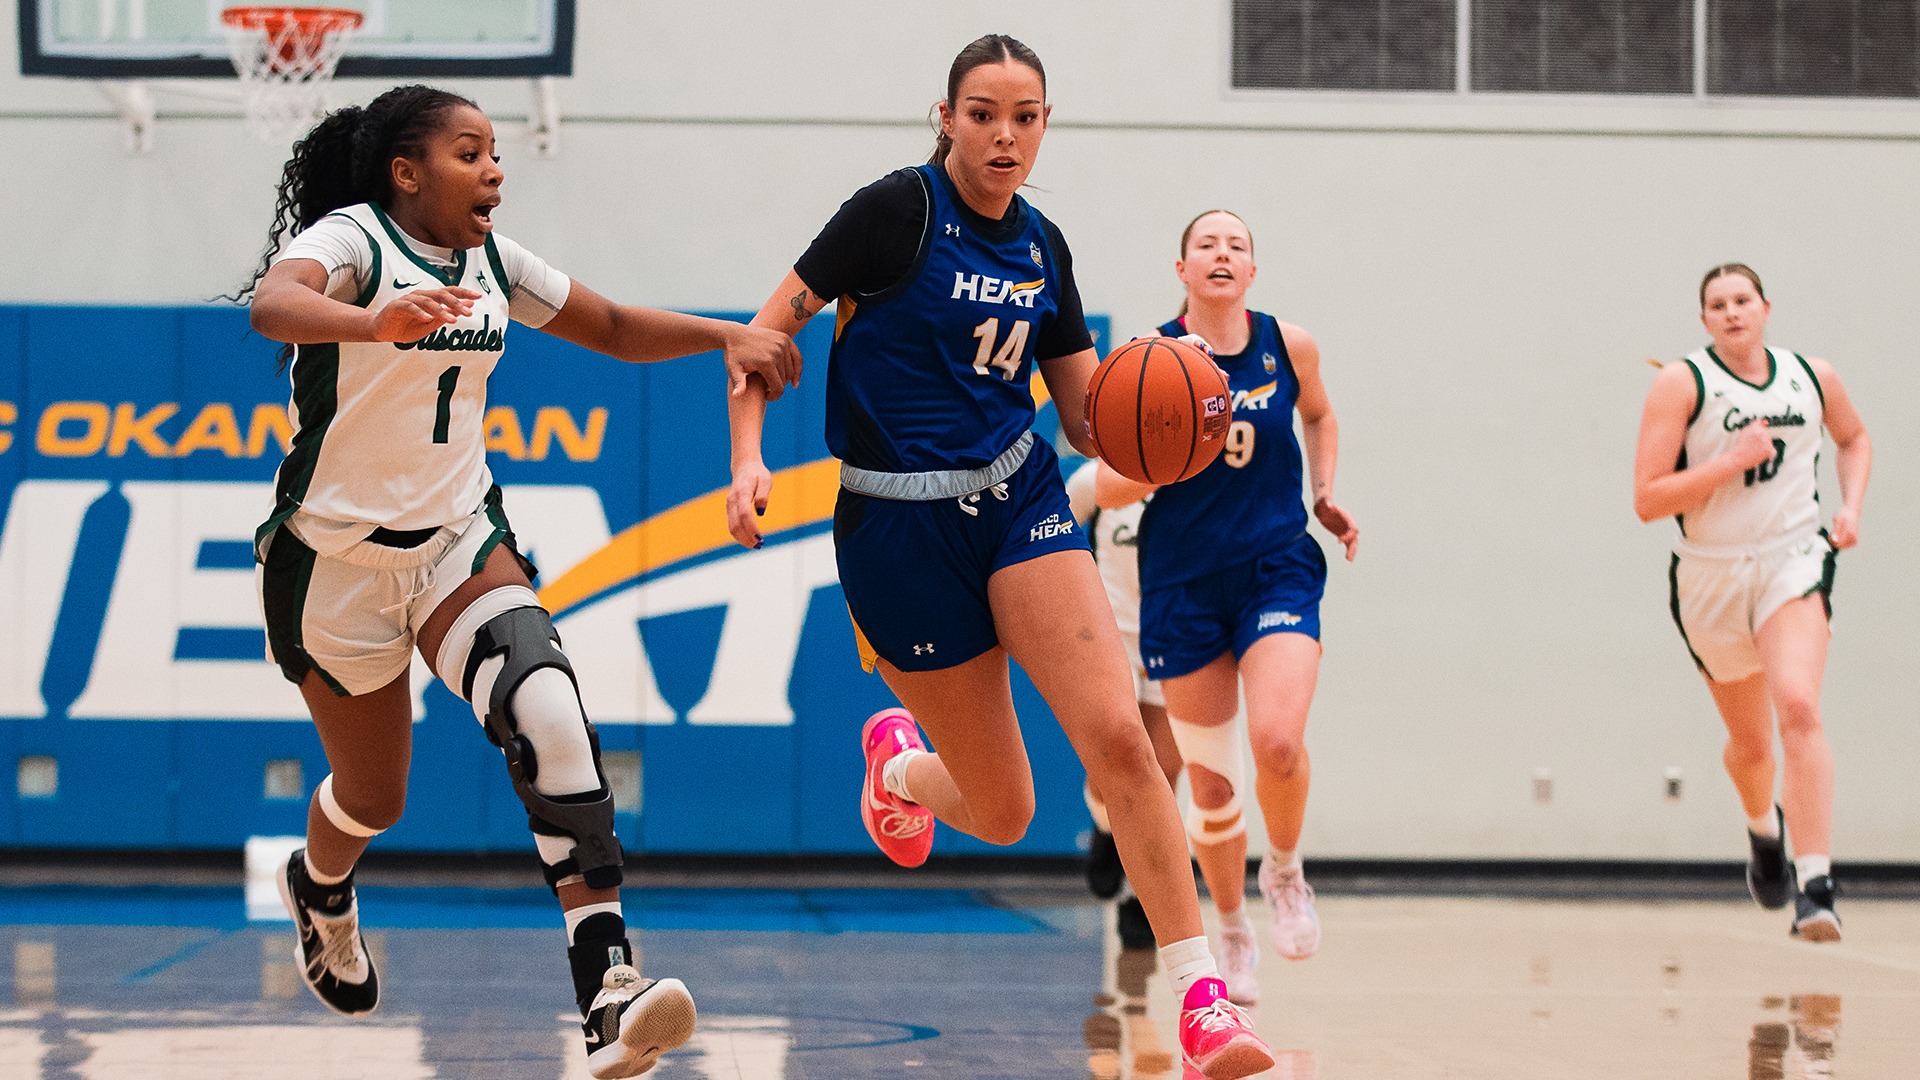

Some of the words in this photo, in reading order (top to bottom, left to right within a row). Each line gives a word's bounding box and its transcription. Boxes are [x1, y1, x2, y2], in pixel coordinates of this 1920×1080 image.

[951, 271, 1046, 309] HEAT
[393, 314, 503, 351] ascades
[972, 316, 1031, 382] 14
[432, 365, 462, 444] 1
[1230, 380, 1278, 412] AT
[36, 401, 608, 460] OKANAN
[1224, 420, 1256, 469] 9
[1030, 520, 1074, 542] HEAT
